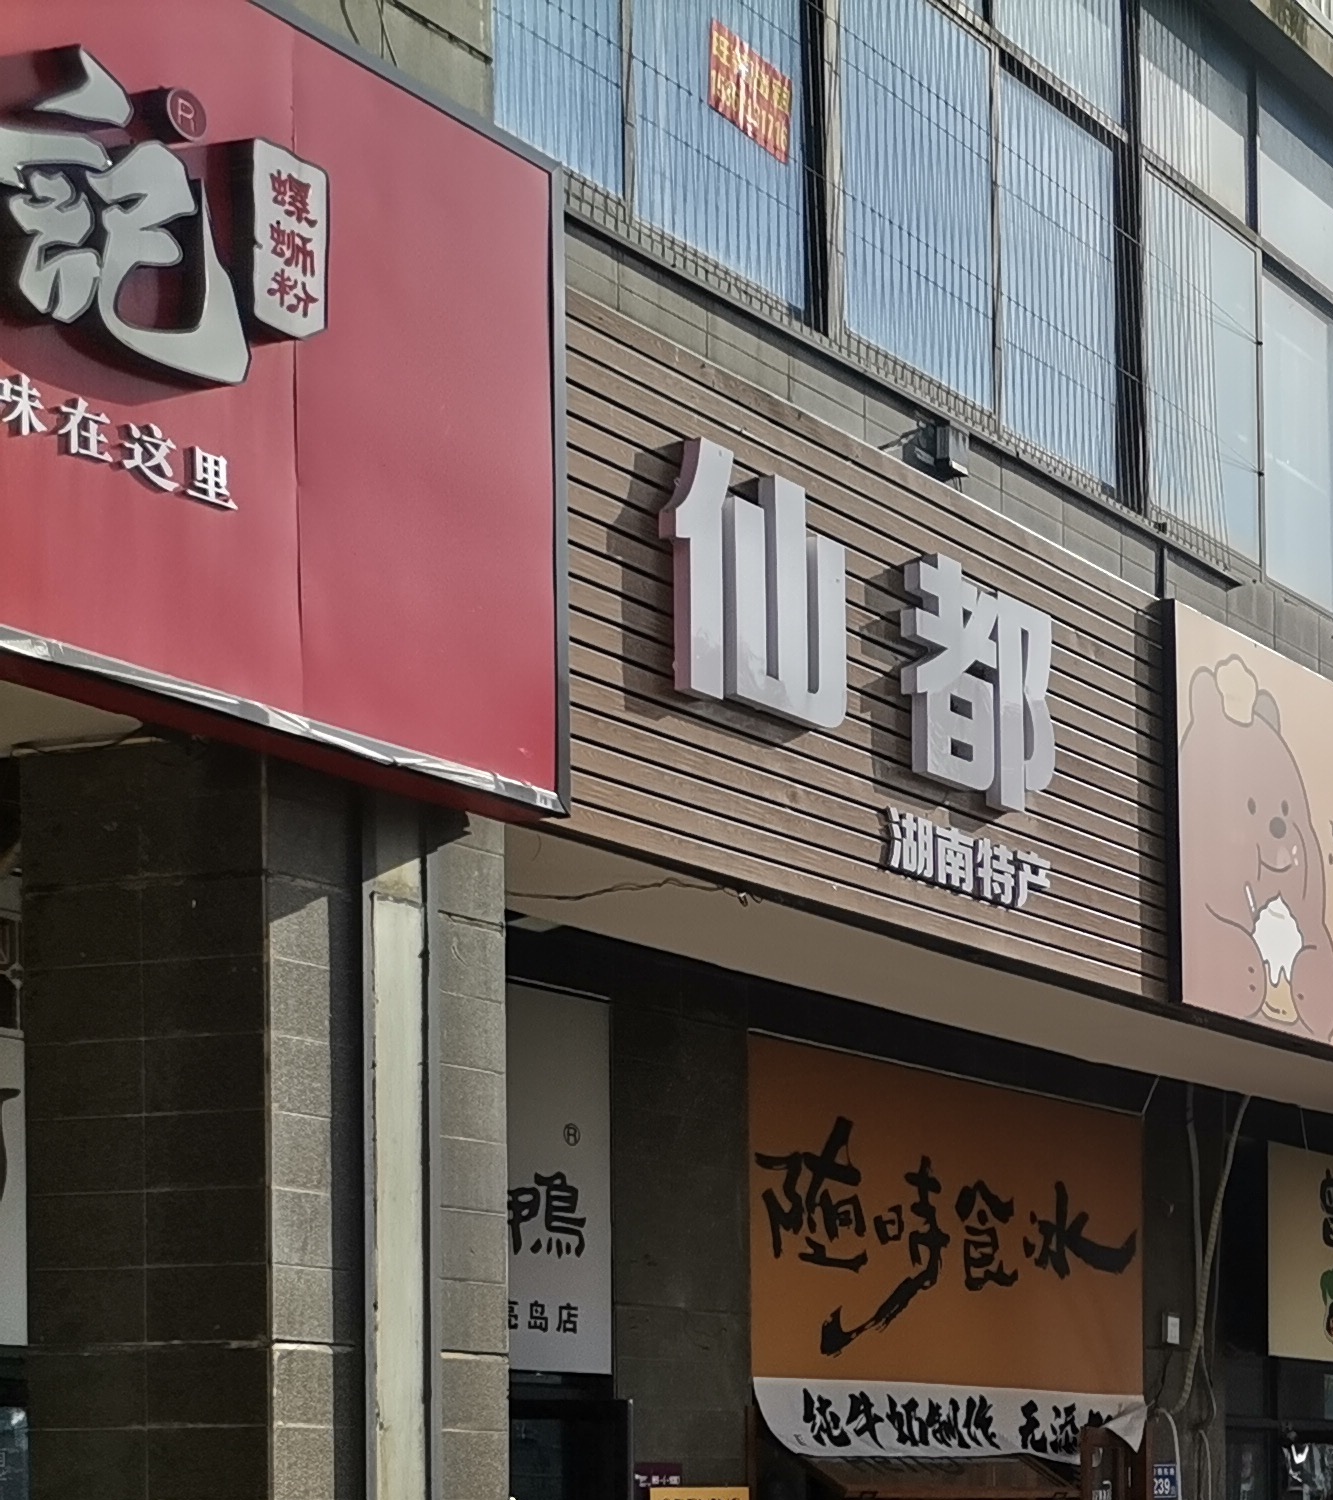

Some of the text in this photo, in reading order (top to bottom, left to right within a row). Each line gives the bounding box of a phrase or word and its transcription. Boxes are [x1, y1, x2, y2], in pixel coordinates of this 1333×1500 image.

[0, 373, 239, 510] 味在这里
[656, 436, 1058, 814] 仙都
[883, 806, 1052, 909] 湖南特产
[802, 1387, 1001, 1450] 纯牛奶制作
